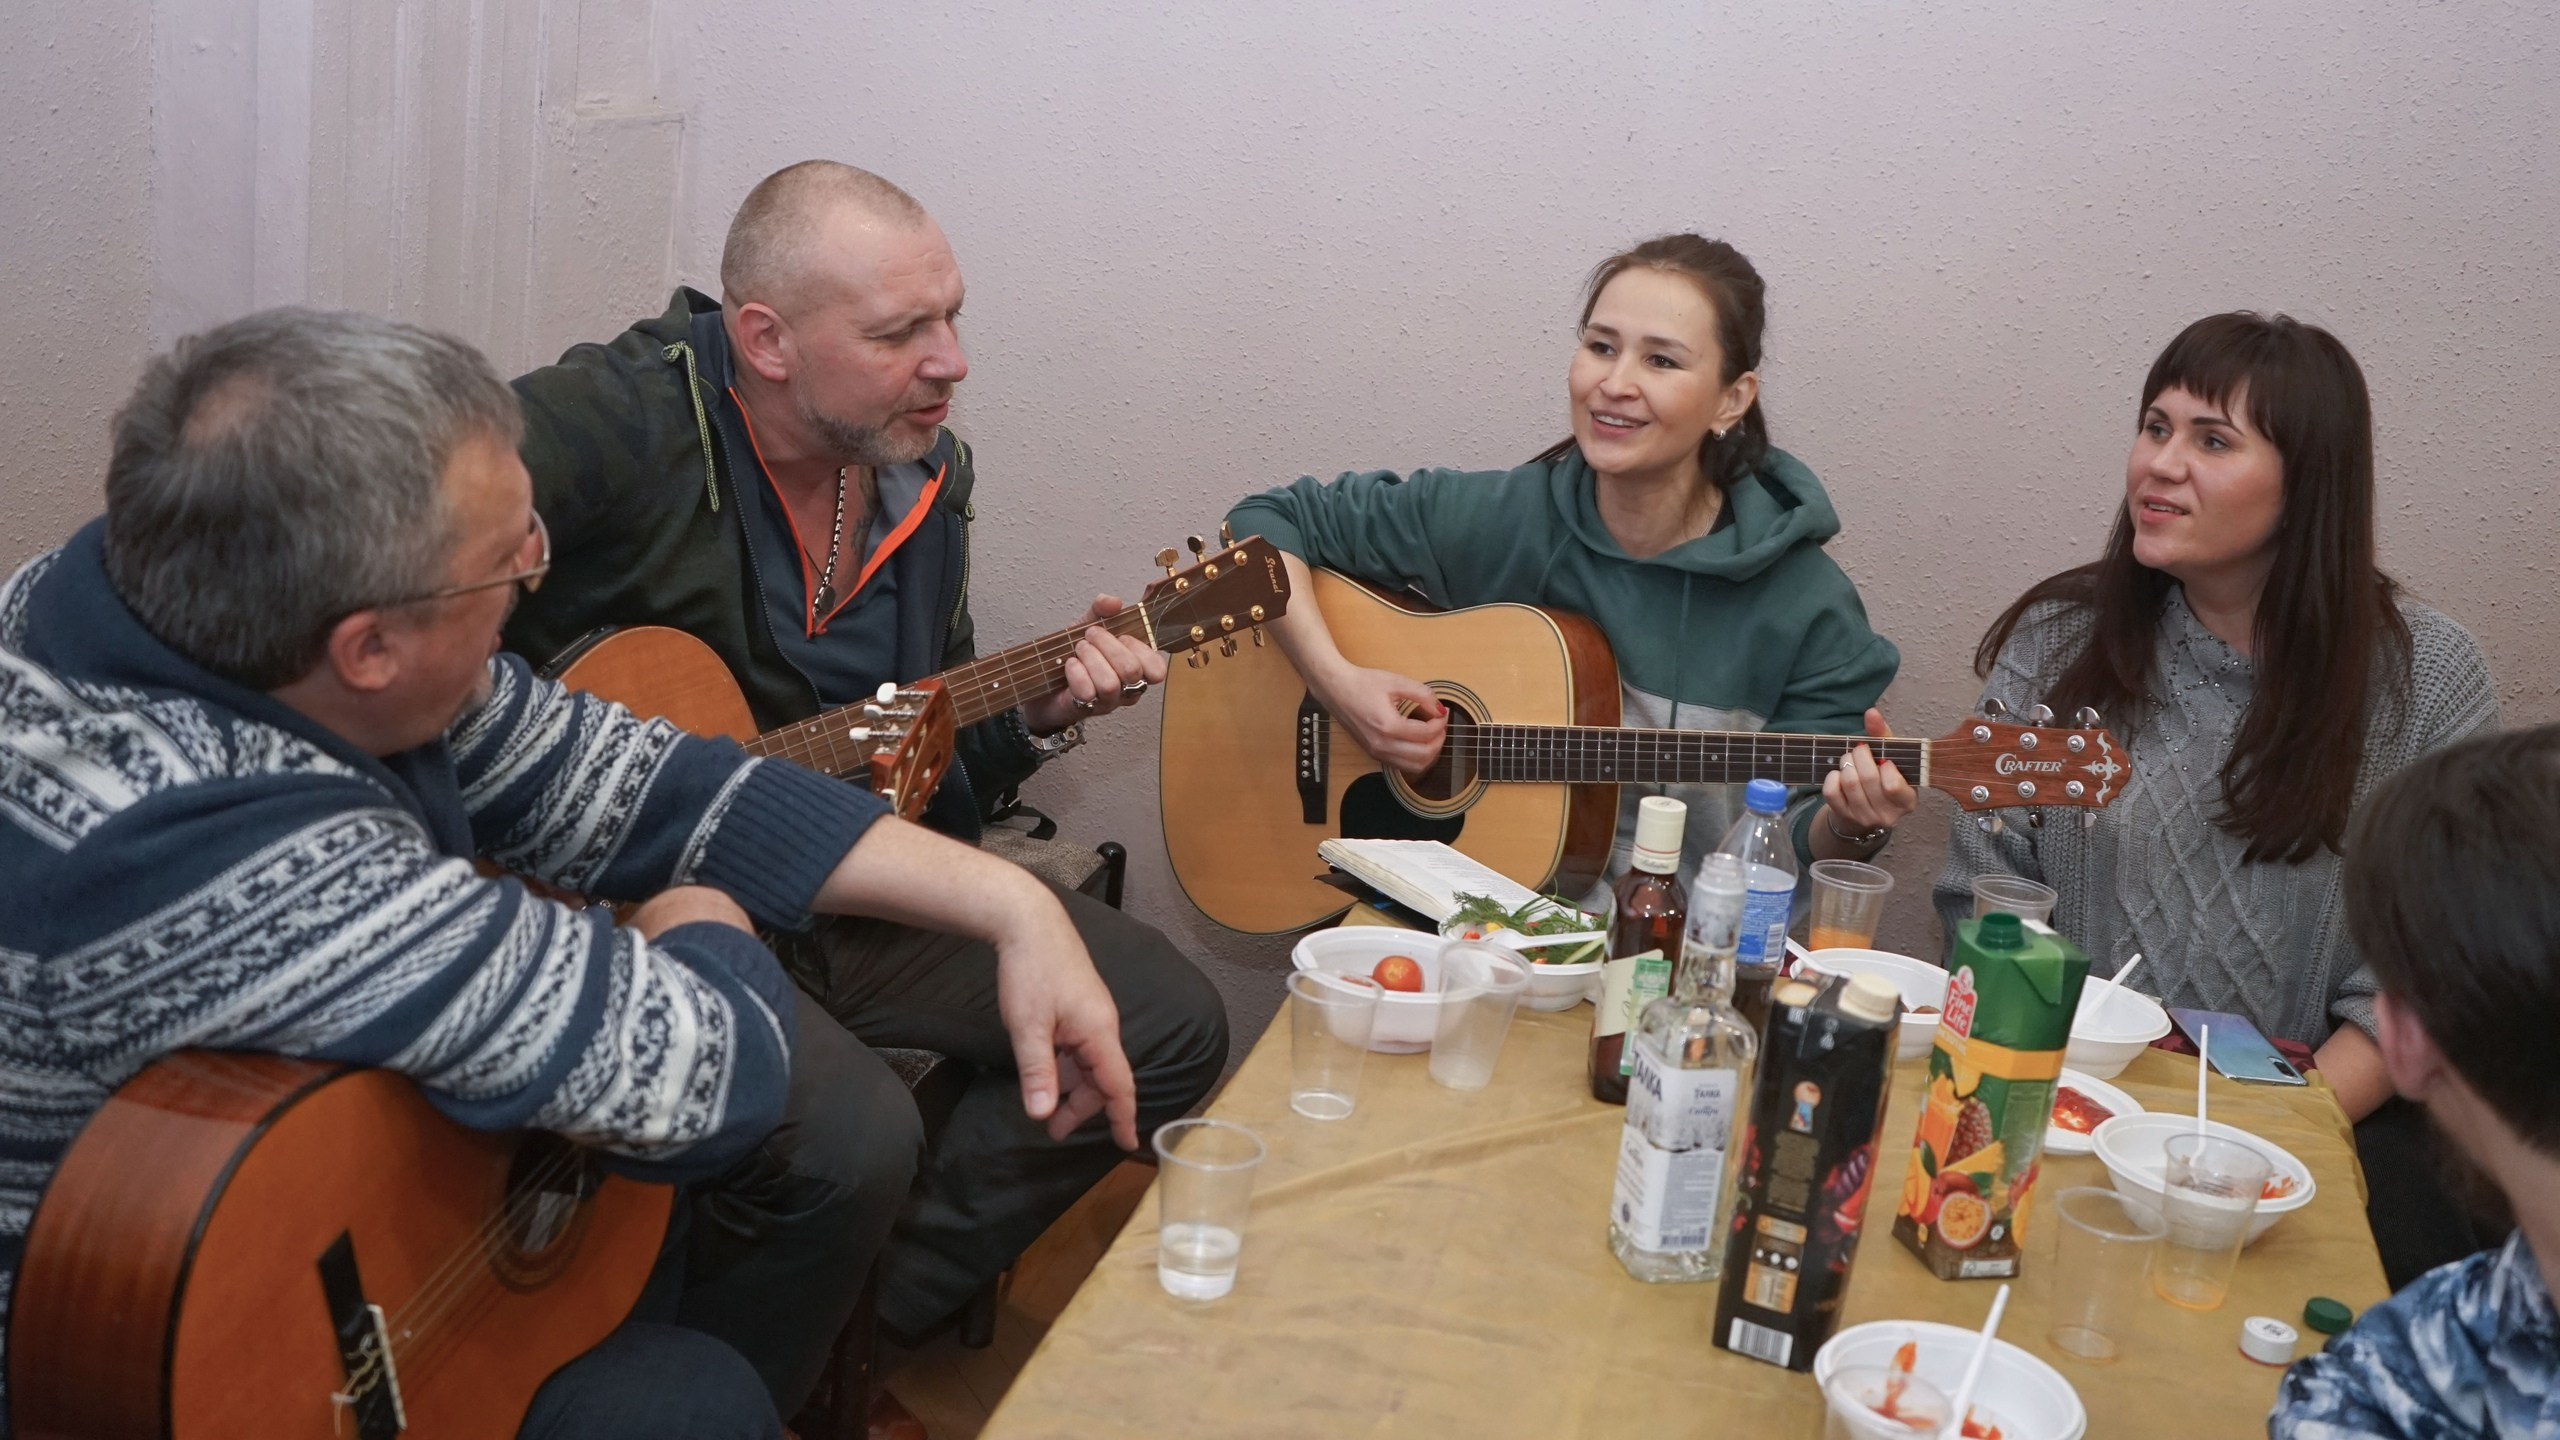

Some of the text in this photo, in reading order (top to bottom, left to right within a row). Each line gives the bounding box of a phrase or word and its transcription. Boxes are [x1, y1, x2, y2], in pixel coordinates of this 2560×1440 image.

[1994, 752, 2063, 776] CRAFTER
[1947, 988, 1973, 1014] Fine
[1945, 1005, 1968, 1031] Life
